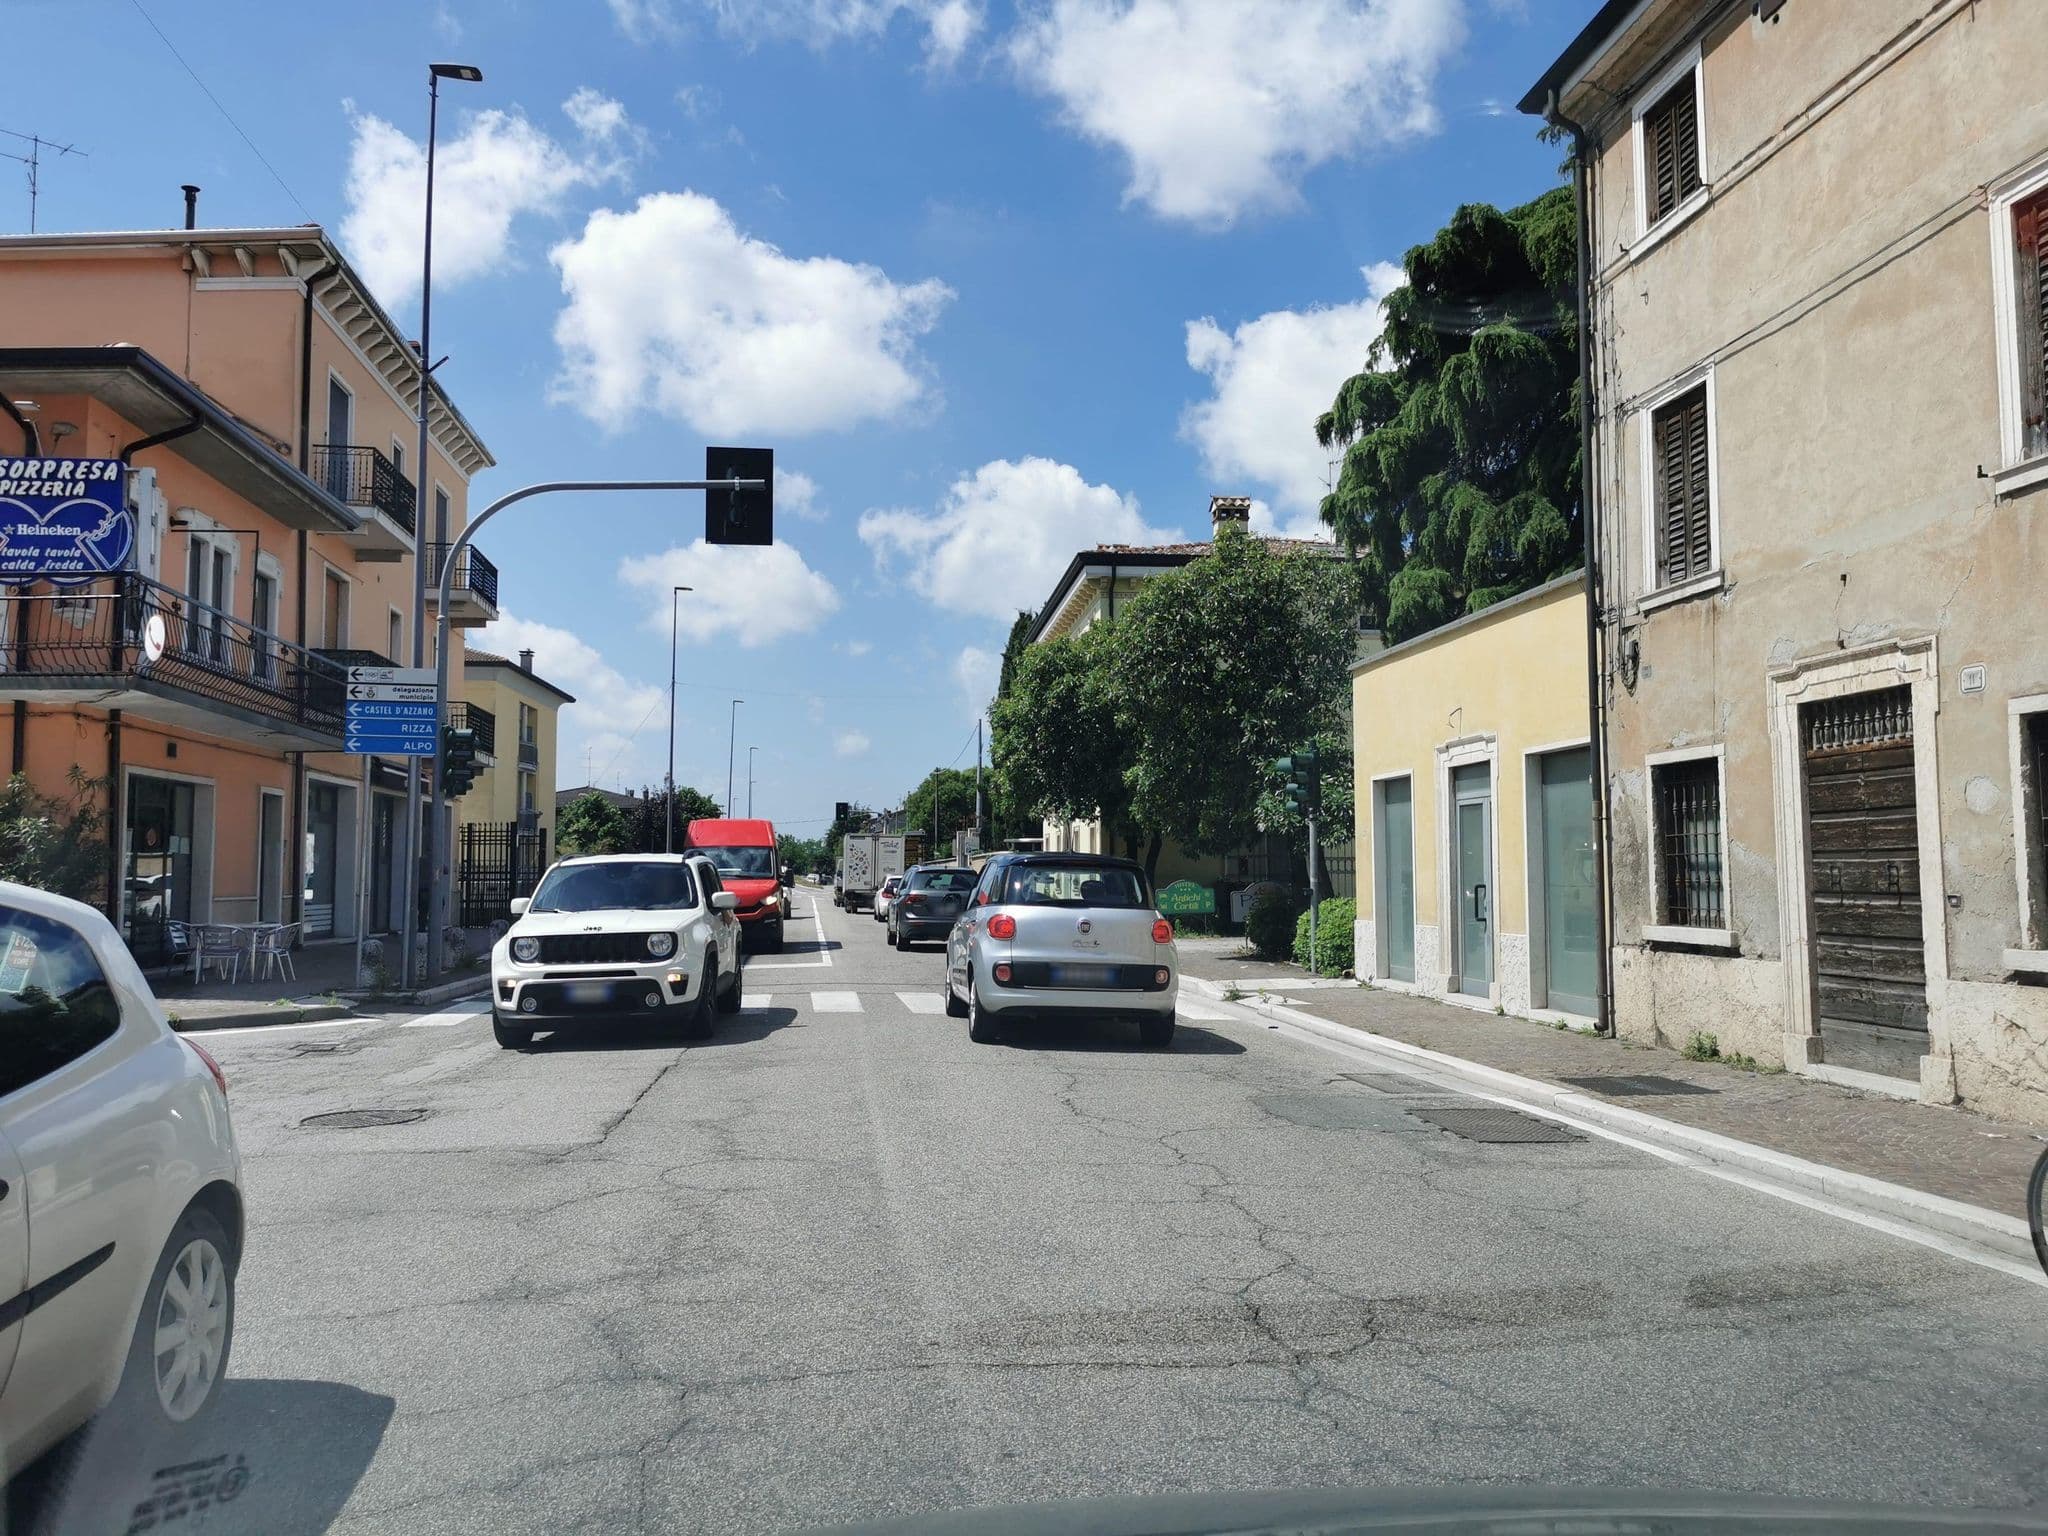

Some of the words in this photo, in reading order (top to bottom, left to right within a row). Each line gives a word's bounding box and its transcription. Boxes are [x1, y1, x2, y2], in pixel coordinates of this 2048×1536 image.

[0, 459, 118, 481] SORPRESA
[0, 480, 85, 496] PIZZERIA
[17, 524, 81, 536] Heineken
[1, 546, 40, 557] tavola
[45, 548, 82, 557] tavola
[1, 560, 36, 570] calda
[44, 560, 84, 570] fredda
[364, 705, 392, 715] CASTEL
[395, 706, 434, 716] D'AZZANO
[401, 725, 433, 733] RIZZA
[403, 742, 433, 751] ALPO
